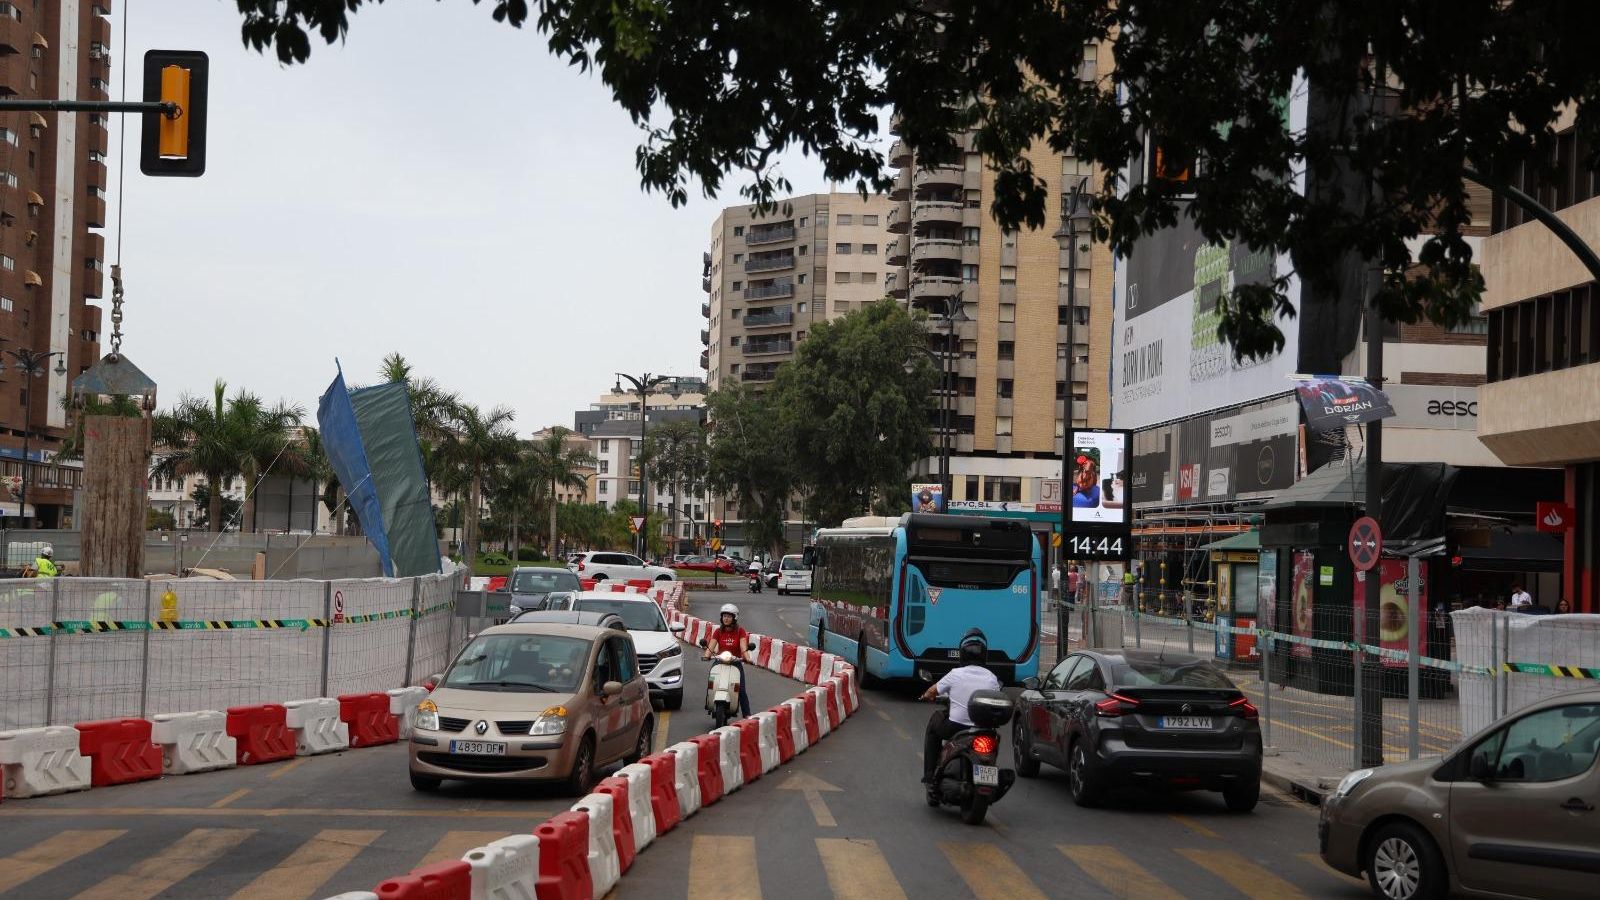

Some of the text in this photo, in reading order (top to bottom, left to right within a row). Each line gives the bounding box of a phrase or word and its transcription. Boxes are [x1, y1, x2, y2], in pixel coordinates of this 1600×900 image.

[1122, 339, 1162, 388] BORN IN ROMA
[1324, 401, 1372, 415] DORIAN
[1070, 536, 1123, 555] 14:44
[1166, 716, 1210, 727] 1792 LVX
[458, 742, 505, 756] 4830 DFW
